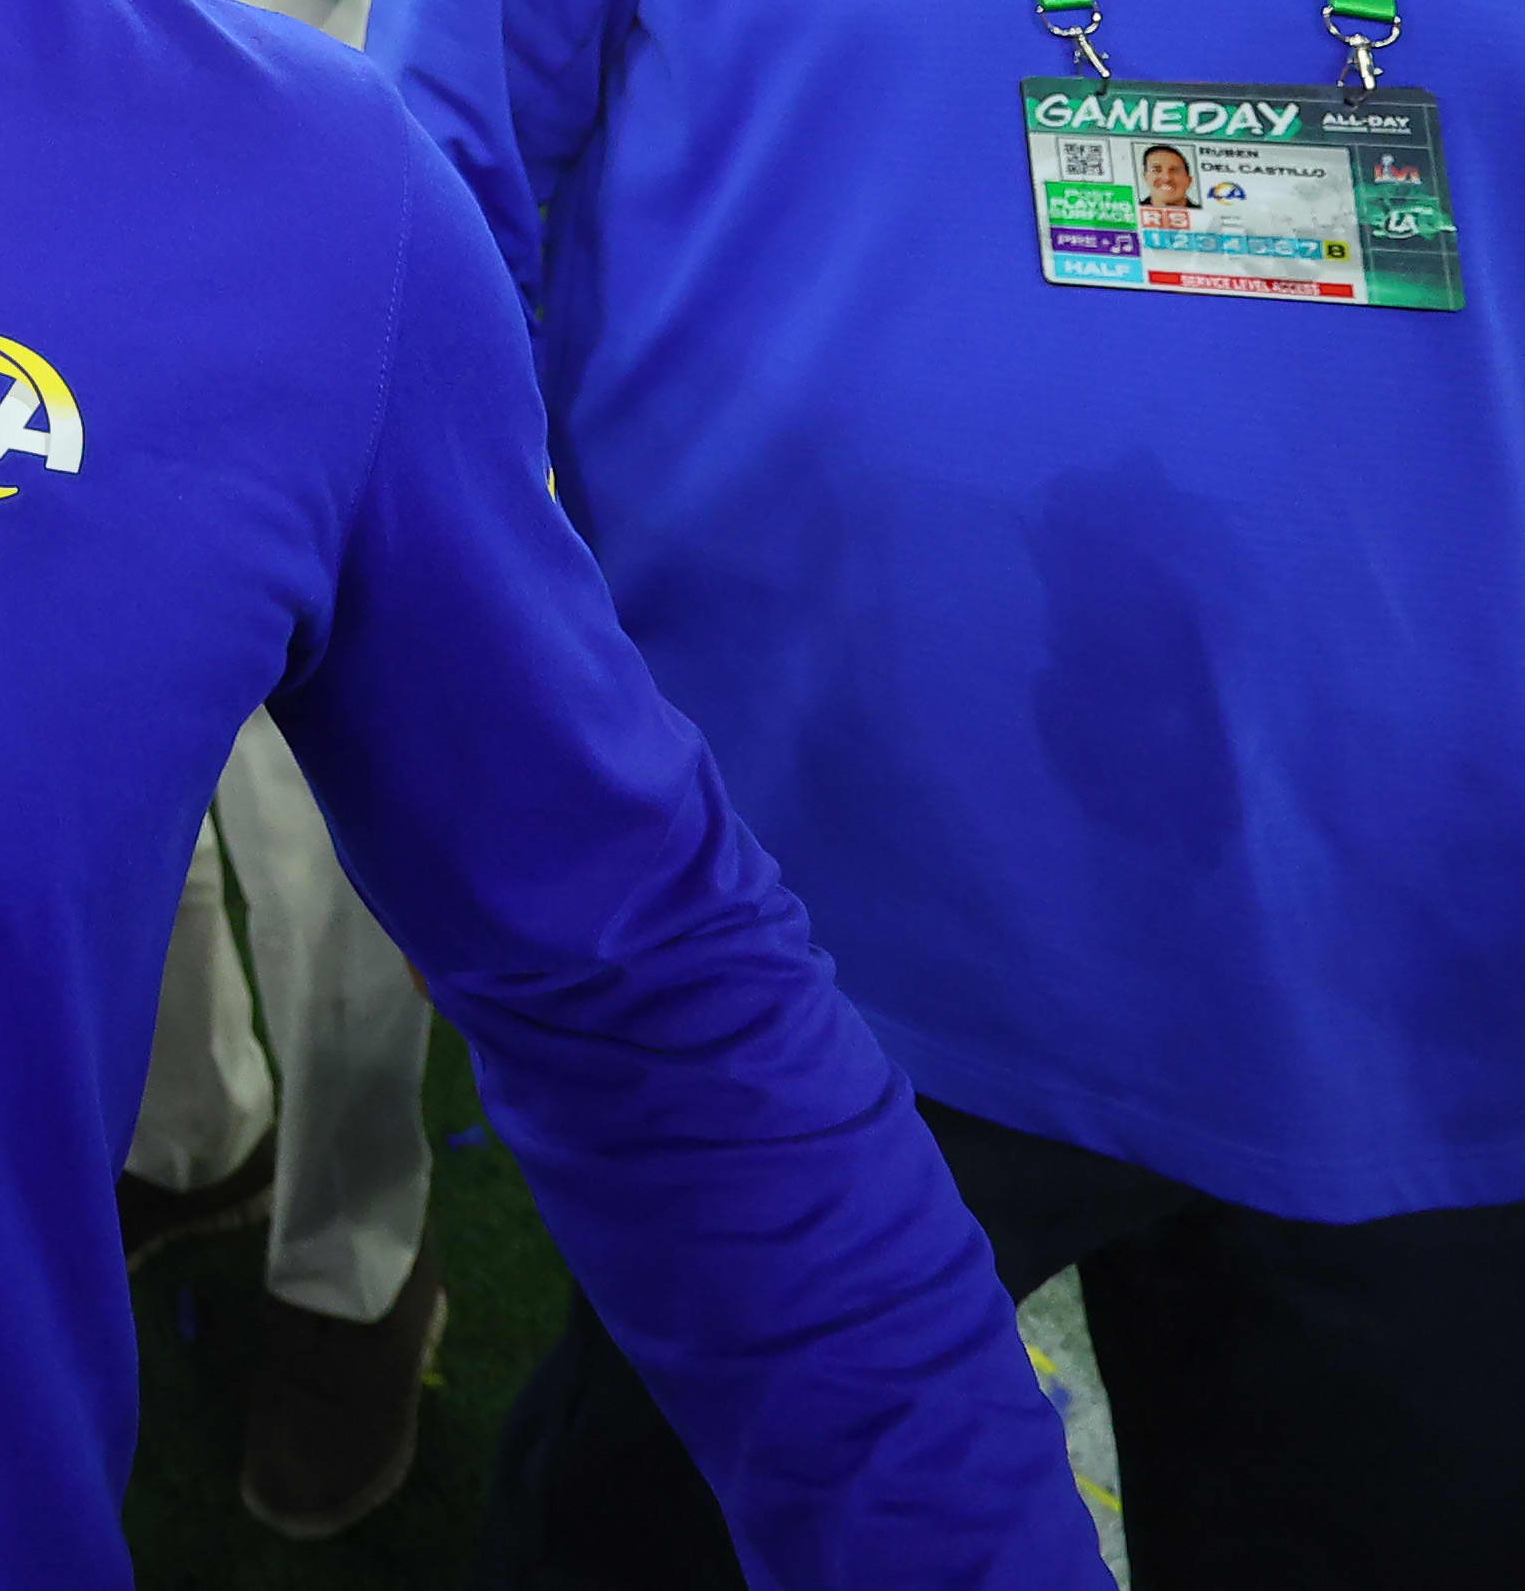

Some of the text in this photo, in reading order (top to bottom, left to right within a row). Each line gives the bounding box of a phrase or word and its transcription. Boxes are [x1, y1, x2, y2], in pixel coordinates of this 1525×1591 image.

[1035, 93, 1299, 137] GAMEDAY
[1323, 113, 1410, 127] ALL-DAY
[1199, 146, 1259, 158] RUBEN
[1201, 162, 1326, 178] DEL CASTILLO
[1064, 260, 1131, 276] HALF
